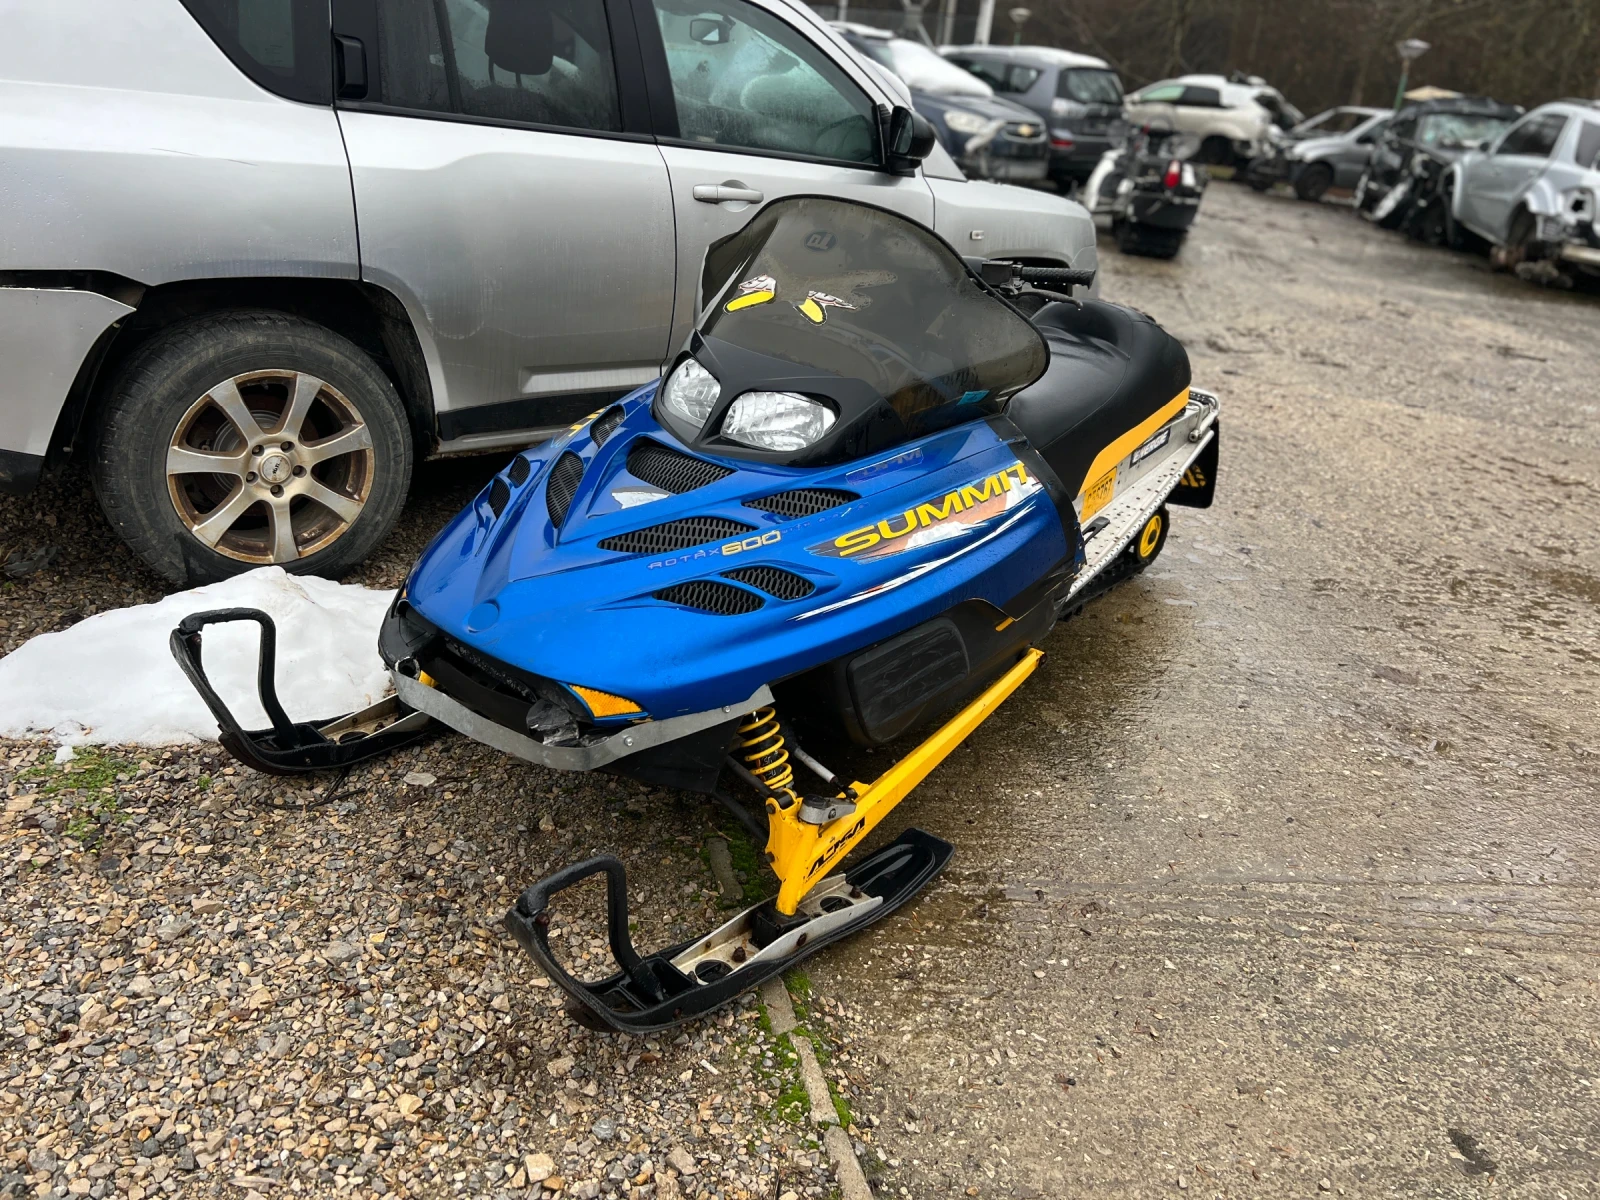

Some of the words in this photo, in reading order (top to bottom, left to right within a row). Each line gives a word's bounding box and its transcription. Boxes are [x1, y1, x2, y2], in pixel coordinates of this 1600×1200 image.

[834, 461, 1028, 557] SUMMIT
[647, 547, 720, 570] ROTAX
[721, 529, 782, 556] 600
